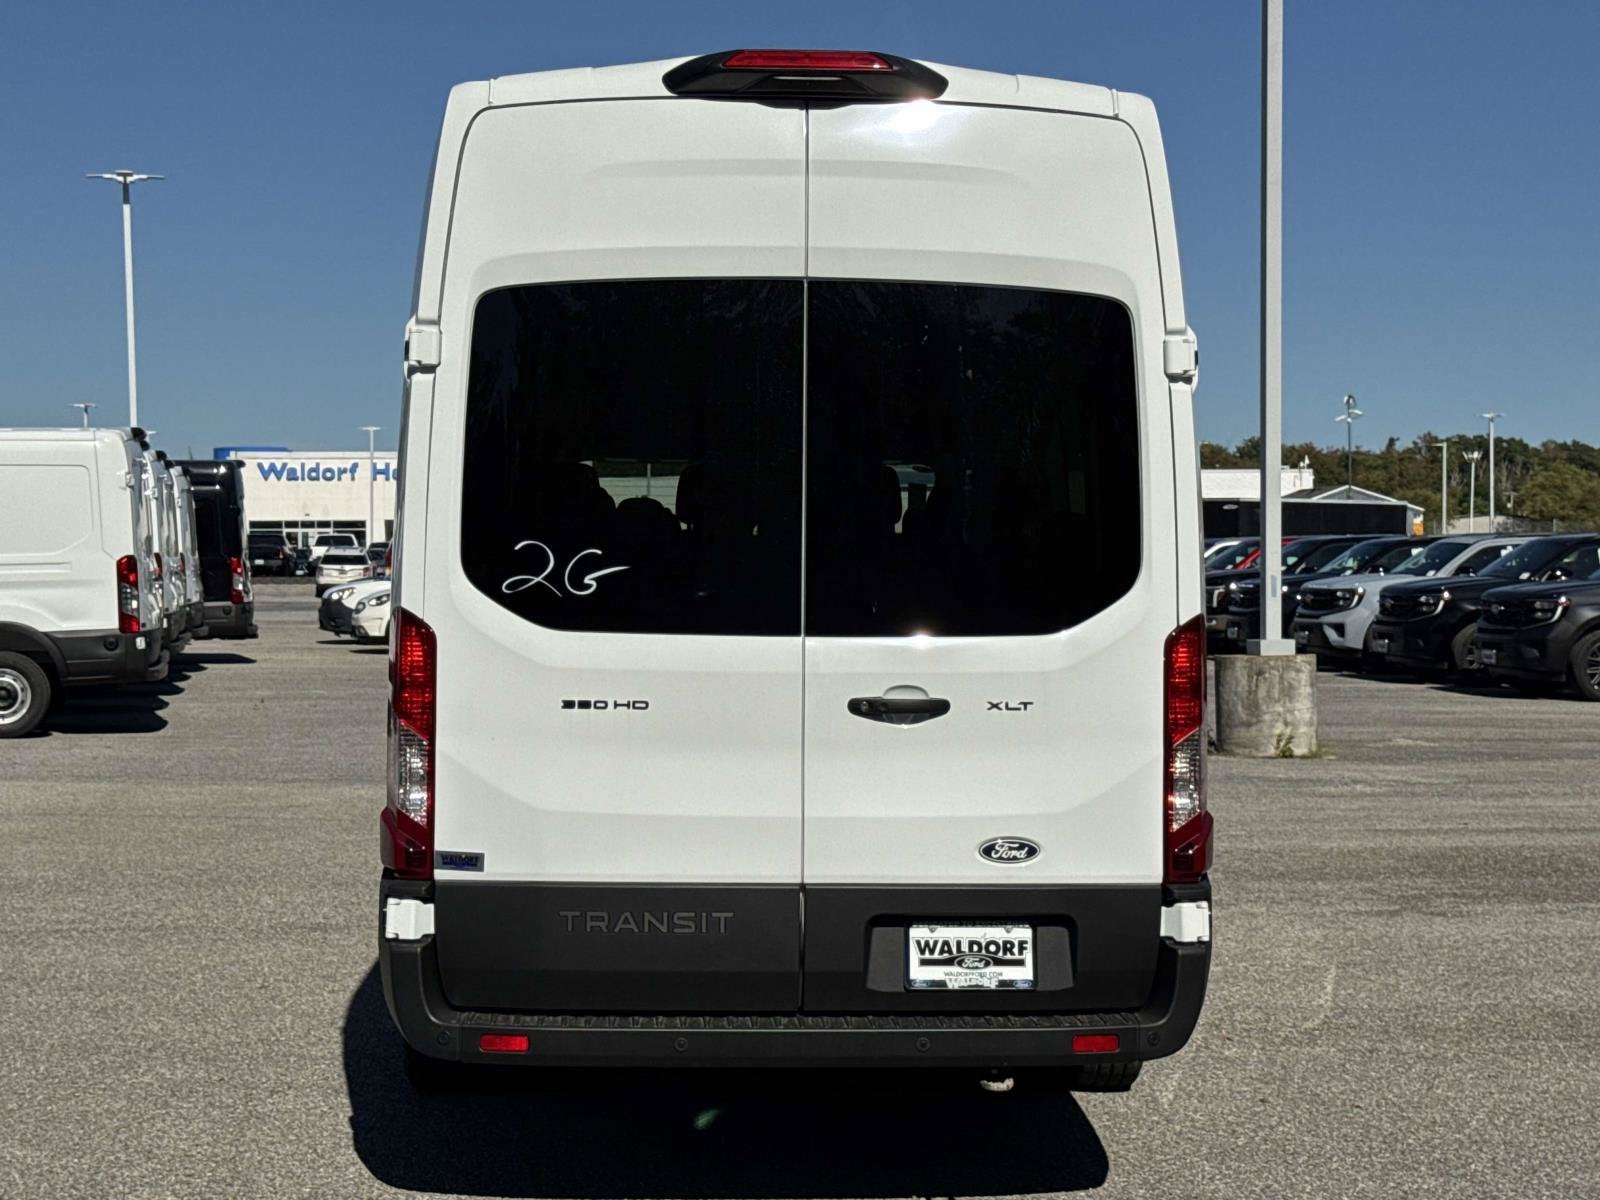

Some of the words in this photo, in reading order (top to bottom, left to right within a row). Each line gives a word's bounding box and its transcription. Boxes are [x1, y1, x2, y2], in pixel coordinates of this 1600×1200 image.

[257, 462, 359, 482] Waldorf
[613, 699, 650, 711] HD
[986, 700, 1034, 711] XLT
[990, 840, 1029, 859] Ford
[559, 910, 736, 934] TRANSIT
[914, 938, 1030, 957] WALDORF
